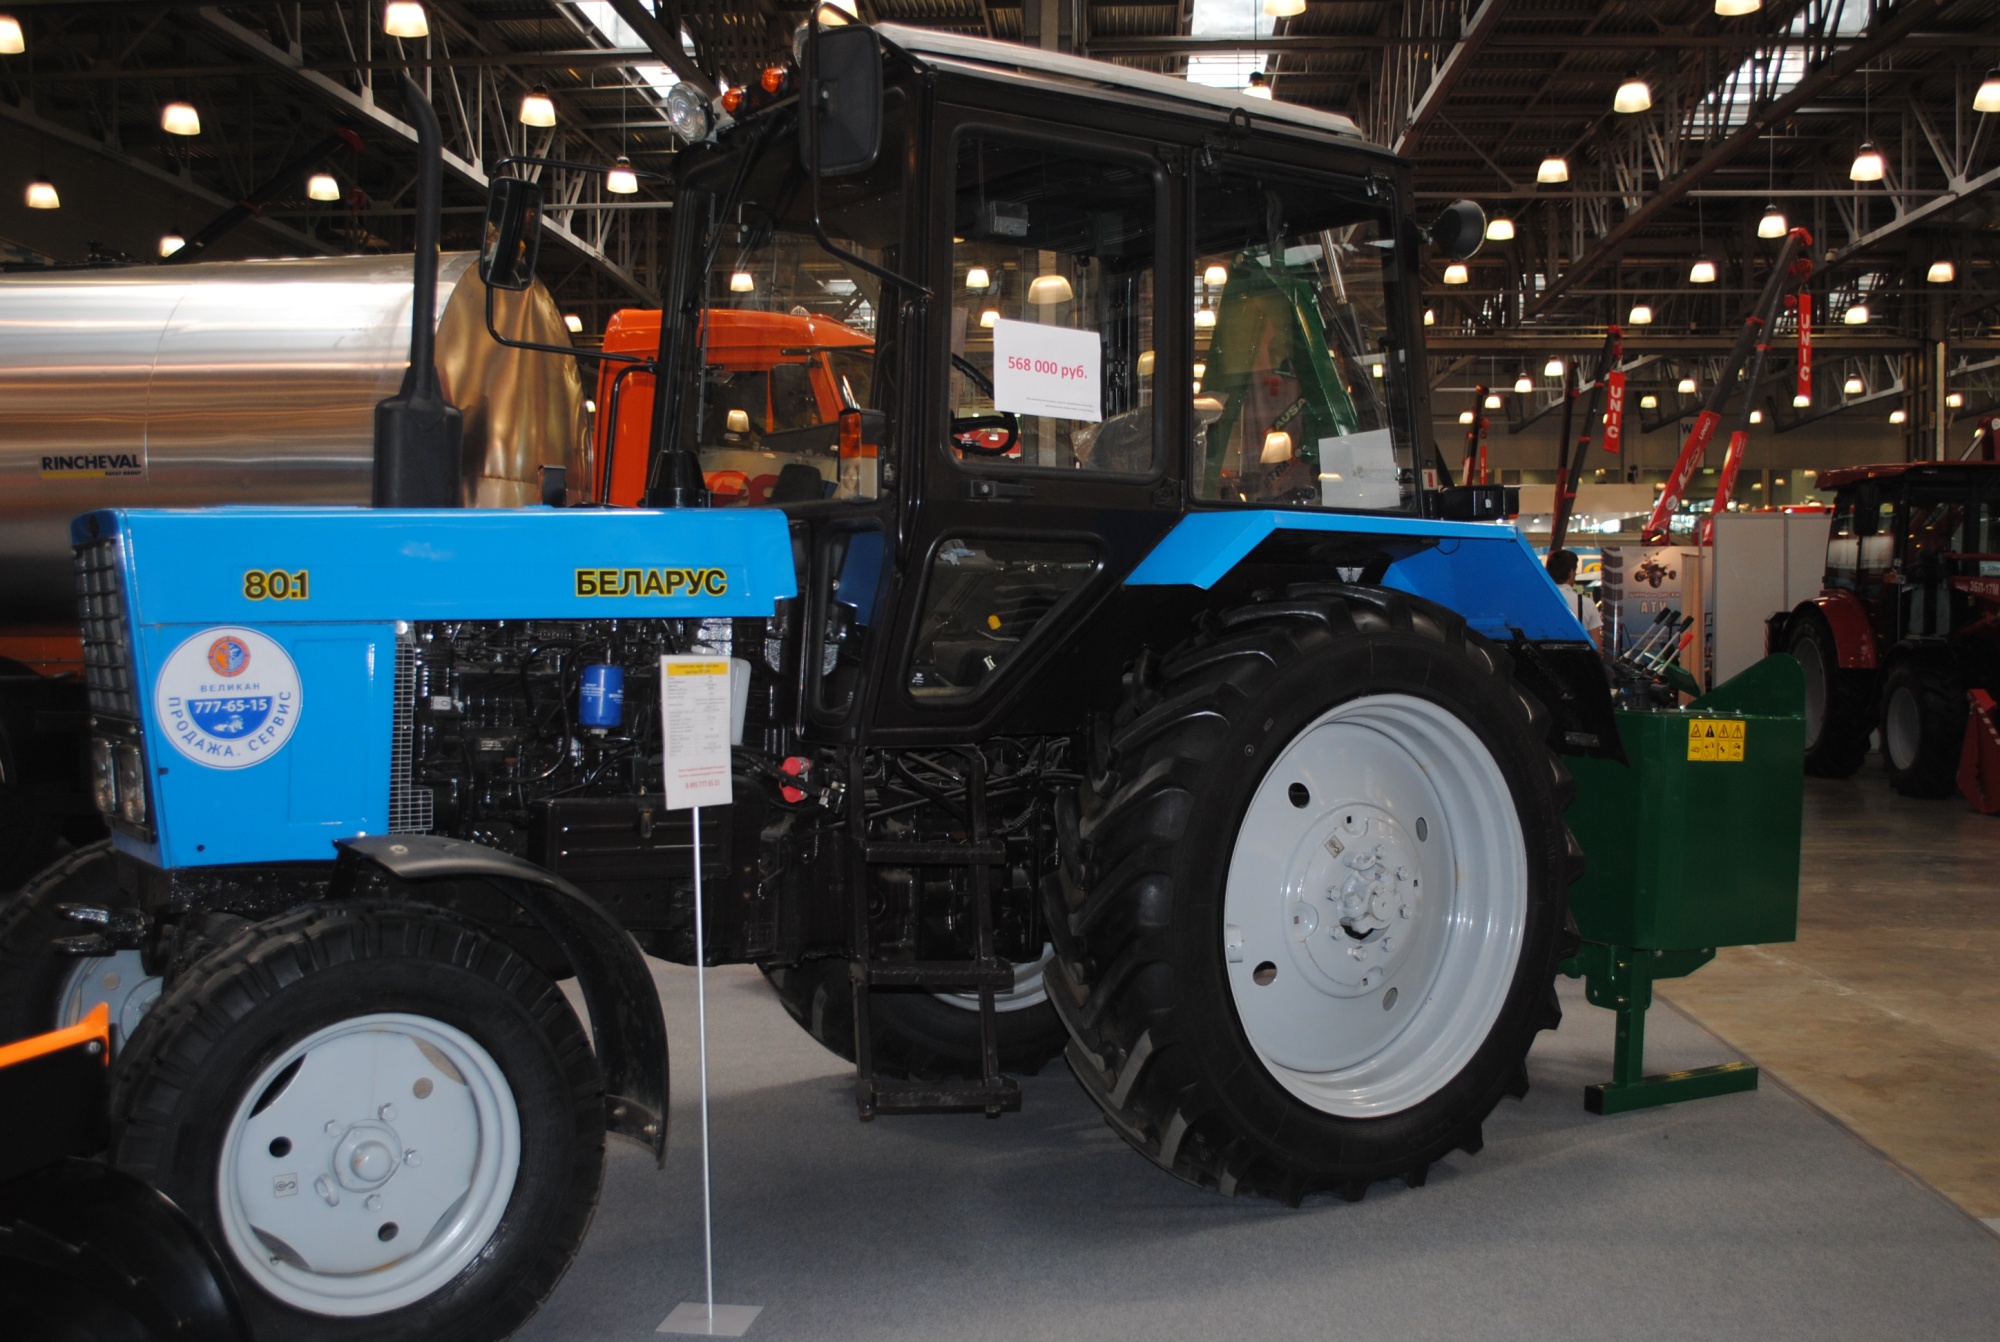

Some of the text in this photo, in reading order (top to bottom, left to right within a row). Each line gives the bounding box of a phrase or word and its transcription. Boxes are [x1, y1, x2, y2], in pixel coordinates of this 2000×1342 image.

[1800, 314, 1810, 382] UNIC
[1008, 356, 1087, 380] 568 000 руб.
[1275, 398, 1306, 431] AUSA
[1607, 385, 1622, 439] UNIC
[1699, 417, 1712, 440] UNIC
[42, 454, 141, 470] RINCHEVAL
[243, 569, 309, 600] 80.1
[575, 568, 728, 597] БЕЛАРУС
[200, 683, 260, 692] ВЕЛИКАН
[194, 698, 268, 714] 777-65-15
[248, 691, 292, 752] СЕРВИС
